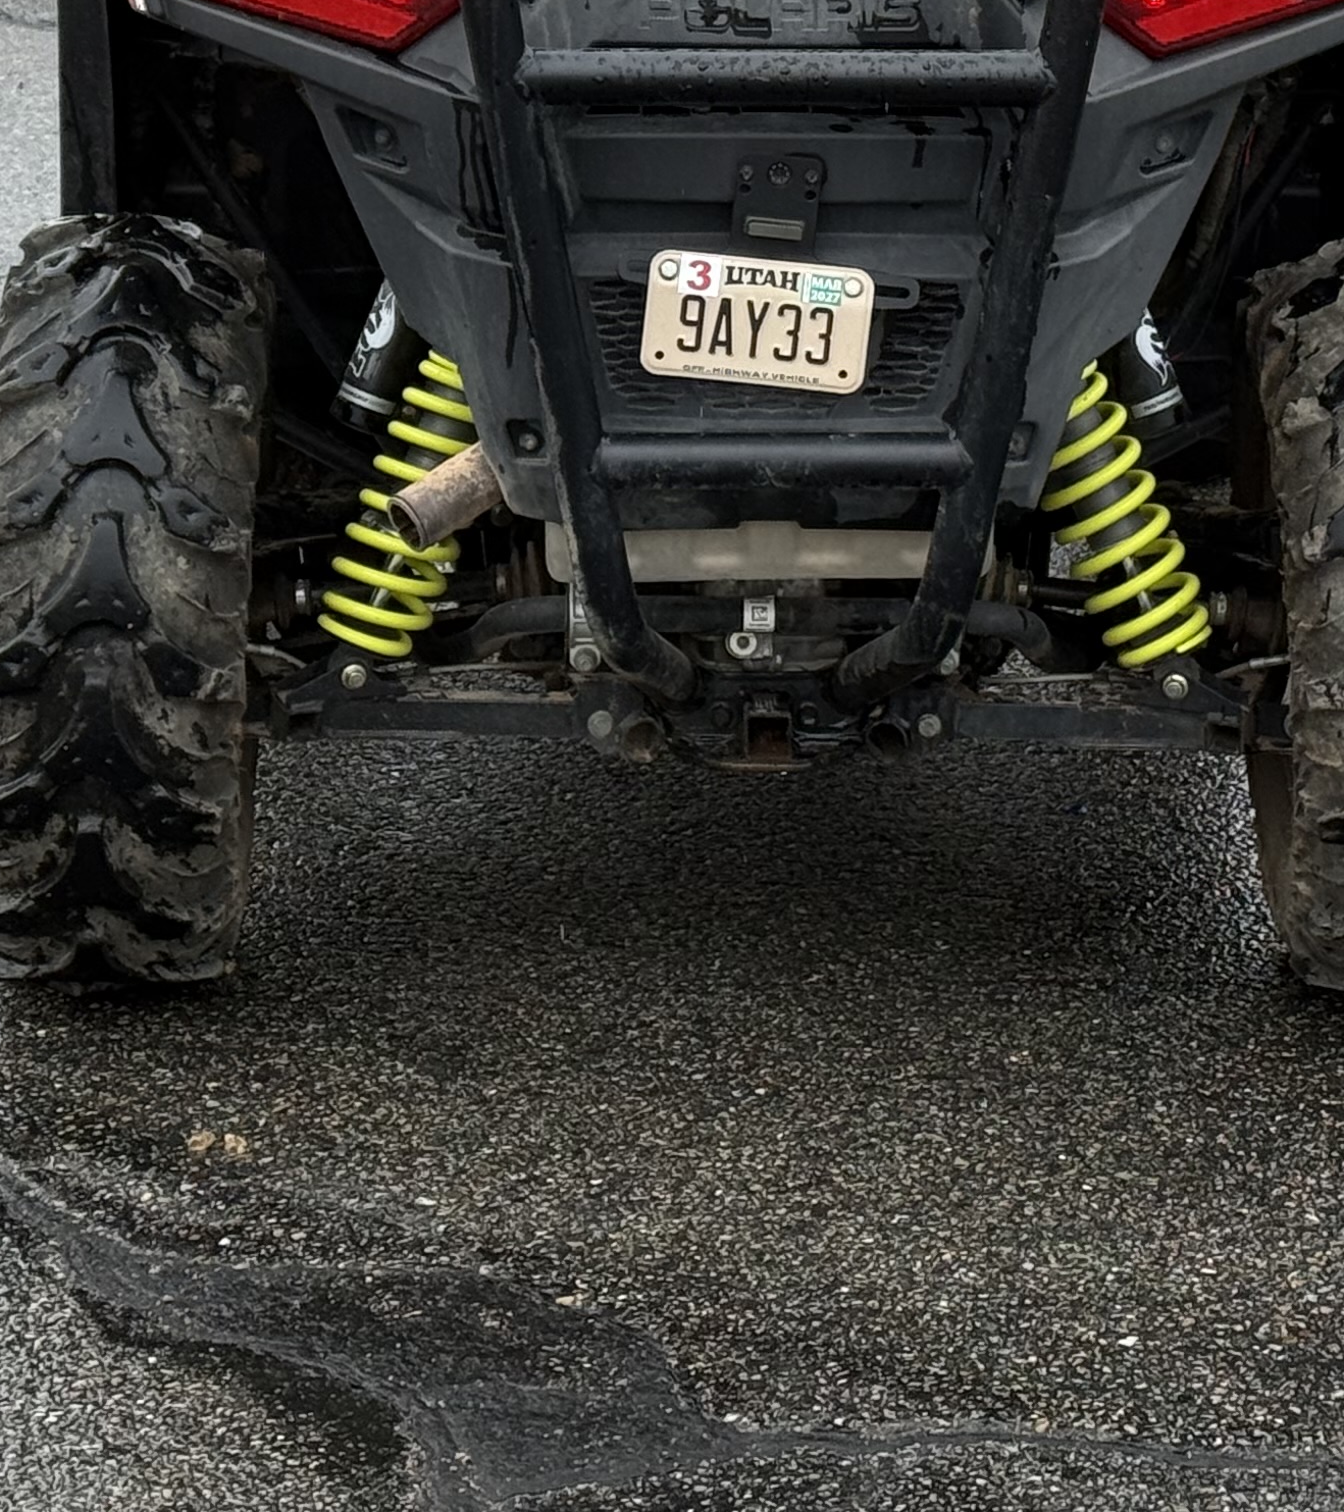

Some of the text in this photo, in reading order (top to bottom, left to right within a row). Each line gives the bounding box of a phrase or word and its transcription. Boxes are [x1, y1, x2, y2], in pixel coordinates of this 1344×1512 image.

[686, 260, 712, 290] 3
[724, 265, 802, 291] UTAH
[810, 290, 842, 304] 2027
[676, 294, 834, 366] 9AY33
